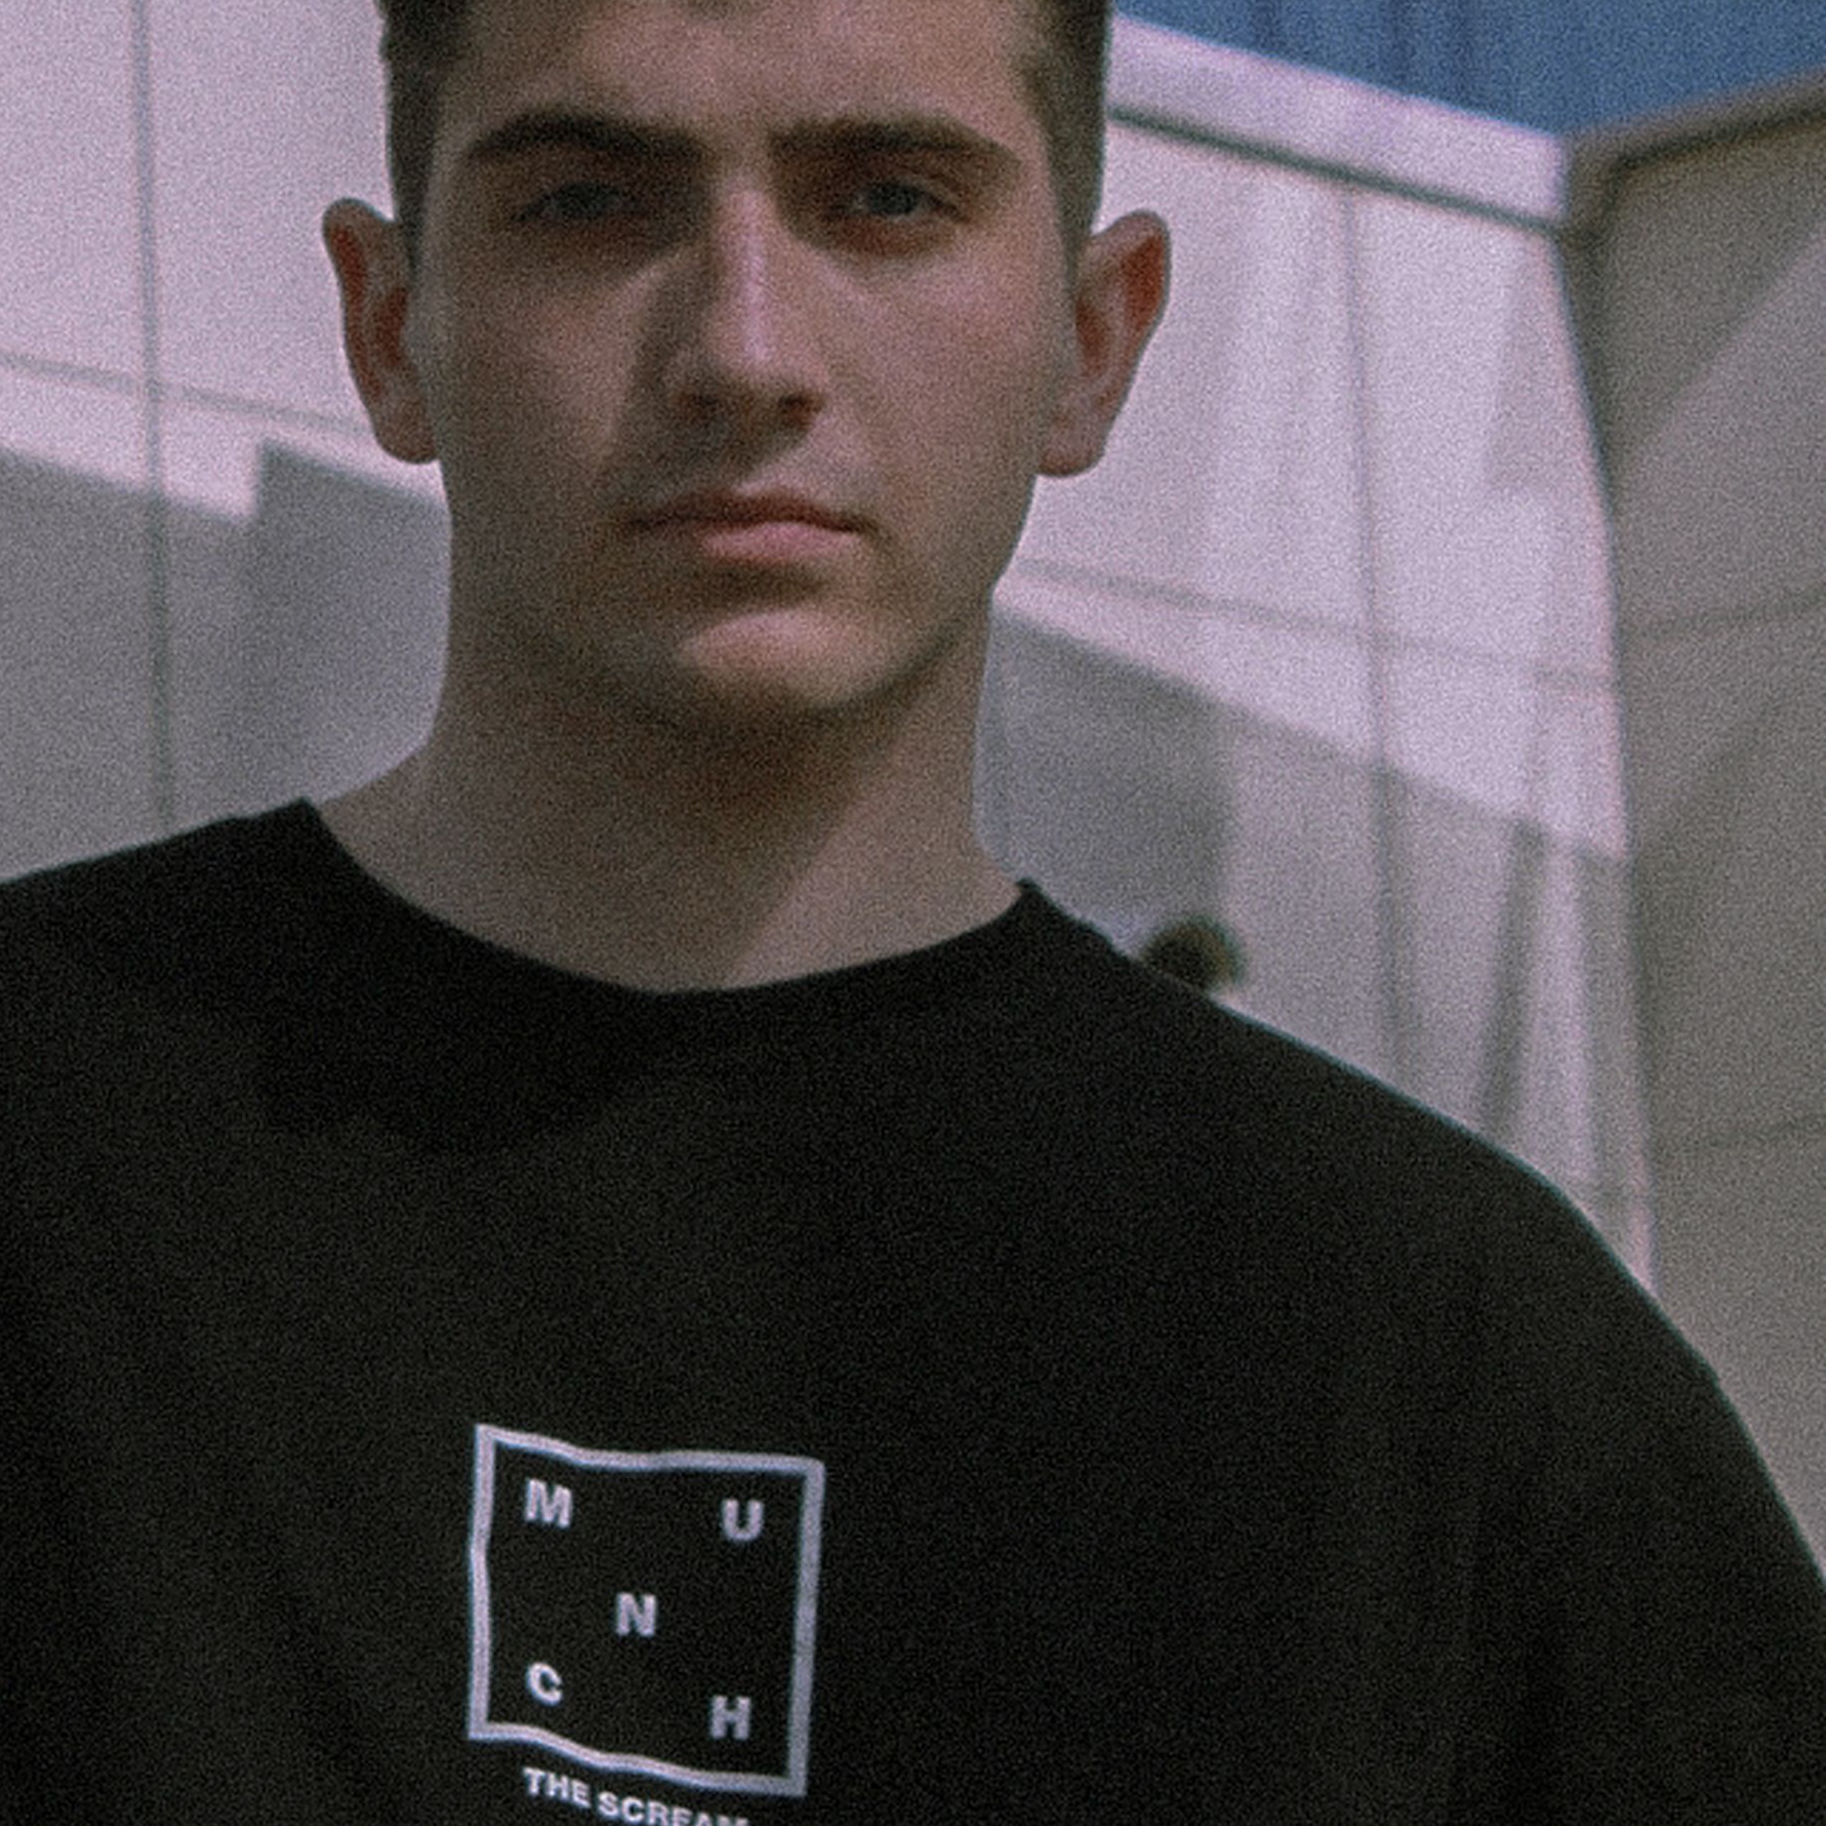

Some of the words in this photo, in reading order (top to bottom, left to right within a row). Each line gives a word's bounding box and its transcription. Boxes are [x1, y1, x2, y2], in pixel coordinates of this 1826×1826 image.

[524, 1478, 574, 1530] M
[721, 1498, 765, 1542] U
[615, 1592, 658, 1638] N
[525, 1662, 565, 1705] C
[709, 1695, 752, 1741] H
[523, 1766, 593, 1808] THE
